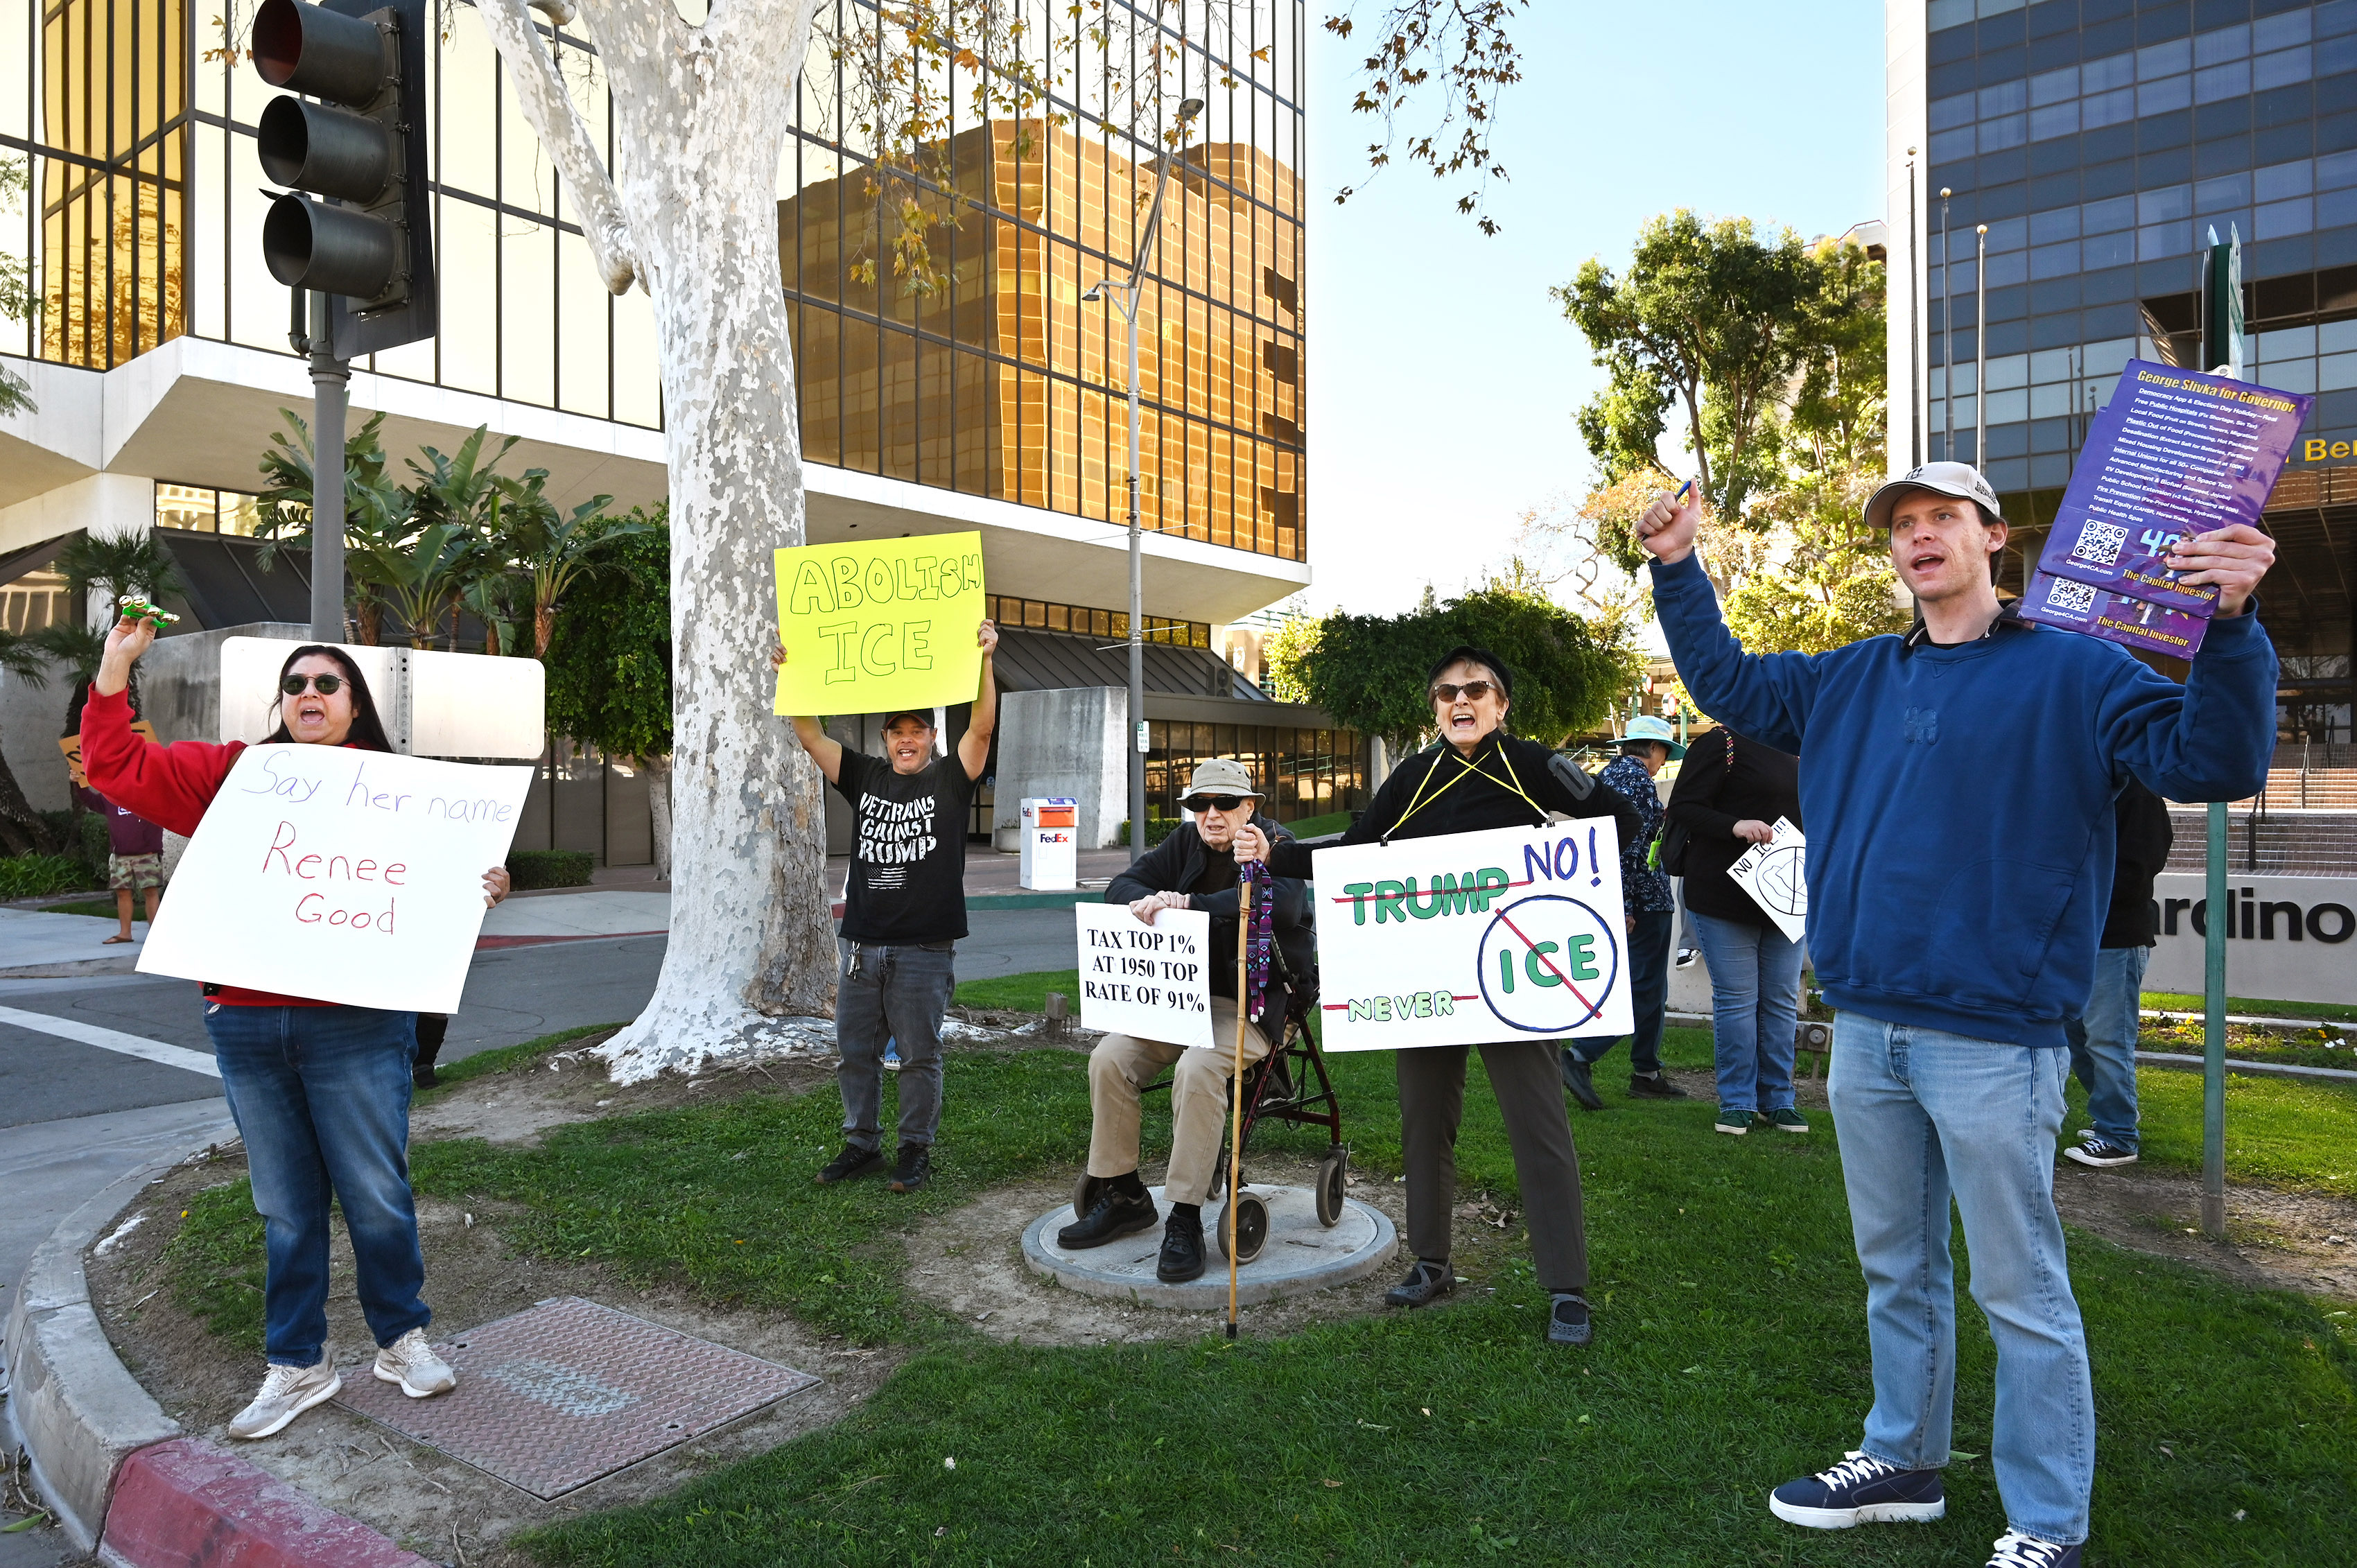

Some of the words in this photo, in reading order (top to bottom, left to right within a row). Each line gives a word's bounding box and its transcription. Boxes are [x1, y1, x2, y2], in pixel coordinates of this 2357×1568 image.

[2137, 370, 2179, 387] George
[2181, 379, 2217, 395] Slivka
[2218, 387, 2237, 399] for
[2238, 392, 2296, 413] Governor
[2139, 387, 2173, 400] Democracy
[2193, 399, 2218, 409] Election
[2130, 407, 2148, 415] Local
[2186, 420, 2207, 429] Streets,
[2209, 425, 2229, 434] Towers,
[2229, 430, 2258, 440] Migration)
[2148, 401, 2168, 409] Public
[2168, 405, 2198, 415] Hospitals
[2209, 414, 2234, 424] Shortage,
[2117, 437, 2137, 445] Mixed
[2137, 441, 2162, 451] Housing
[2162, 447, 2206, 461] Developments
[2122, 427, 2159, 439] Desalination
[2159, 436, 2180, 444] (Extract
[2200, 445, 2226, 455] Batteries,
[2227, 451, 2253, 462] Fertilizer)
[2125, 417, 2146, 426] Plastic
[2183, 430, 2216, 442] (Processing,
[2227, 440, 2259, 451] Packaging)
[2109, 456, 2139, 467] Advanced
[2139, 463, 2183, 478] Manufacturing
[2196, 476, 2216, 485] Space
[2218, 481, 2232, 489] Tech
[2113, 446, 2137, 456] Internal
[2137, 452, 2158, 461] Unions
[2190, 464, 2225, 476] Companies
[2101, 475, 2119, 484] Public
[2120, 480, 2141, 489] School
[2141, 485, 2171, 496] Extension
[2195, 498, 2218, 508] Housing
[2114, 468, 2154, 481] Development
[2160, 478, 2182, 487] Biofuel
[2182, 485, 2209, 495] (Seaweed,
[2209, 491, 2231, 500] Jojoba)
[2088, 504, 2107, 513] Public
[2107, 509, 2127, 518] Health
[2128, 514, 2143, 522] Spas
[2093, 494, 2117, 505] Transit
[2132, 505, 2155, 514] (CAHSR,
[2173, 514, 2189, 523] Trails)
[2108, 488, 2141, 500] Prevention
[2141, 496, 2169, 506] (Fire-Proof
[2169, 503, 2192, 513] Housing,
[2193, 509, 2222, 520] Hydration)
[2066, 559, 2112, 575] George4CA.com
[790, 554, 982, 614] ABOLISH
[2122, 568, 2139, 580] The
[2140, 574, 2174, 589] Capital
[2175, 583, 2214, 600] Investor
[2040, 606, 2088, 623] George4CA.com
[2096, 616, 2114, 628] The
[2114, 619, 2148, 637] Capital
[2148, 629, 2190, 647] Investor
[818, 620, 933, 686] ICE
[241, 750, 322, 803] Say
[346, 761, 412, 812] her
[428, 796, 512, 823] name
[860, 812, 935, 842] GAINST
[1040, 833, 1068, 843] FedEx
[263, 821, 406, 885] Renee
[1524, 826, 1601, 887] NO!
[1733, 857, 1752, 878] NO
[1343, 867, 1510, 925] TRUMP
[295, 893, 394, 935] Good
[2151, 887, 2356, 944] rdino
[1087, 929, 1123, 950] TAX
[1127, 930, 1164, 951] TOP
[1169, 934, 1195, 955] 1%
[1093, 955, 1115, 973] AT
[1121, 957, 1155, 978] 1950
[1160, 961, 1198, 982] TOP
[1499, 934, 1599, 994] ICE
[1085, 981, 1132, 1002] RATE
[1136, 986, 1161, 1005] OF
[1167, 991, 1205, 1013] 91%
[1348, 991, 1454, 1022] NEVER
